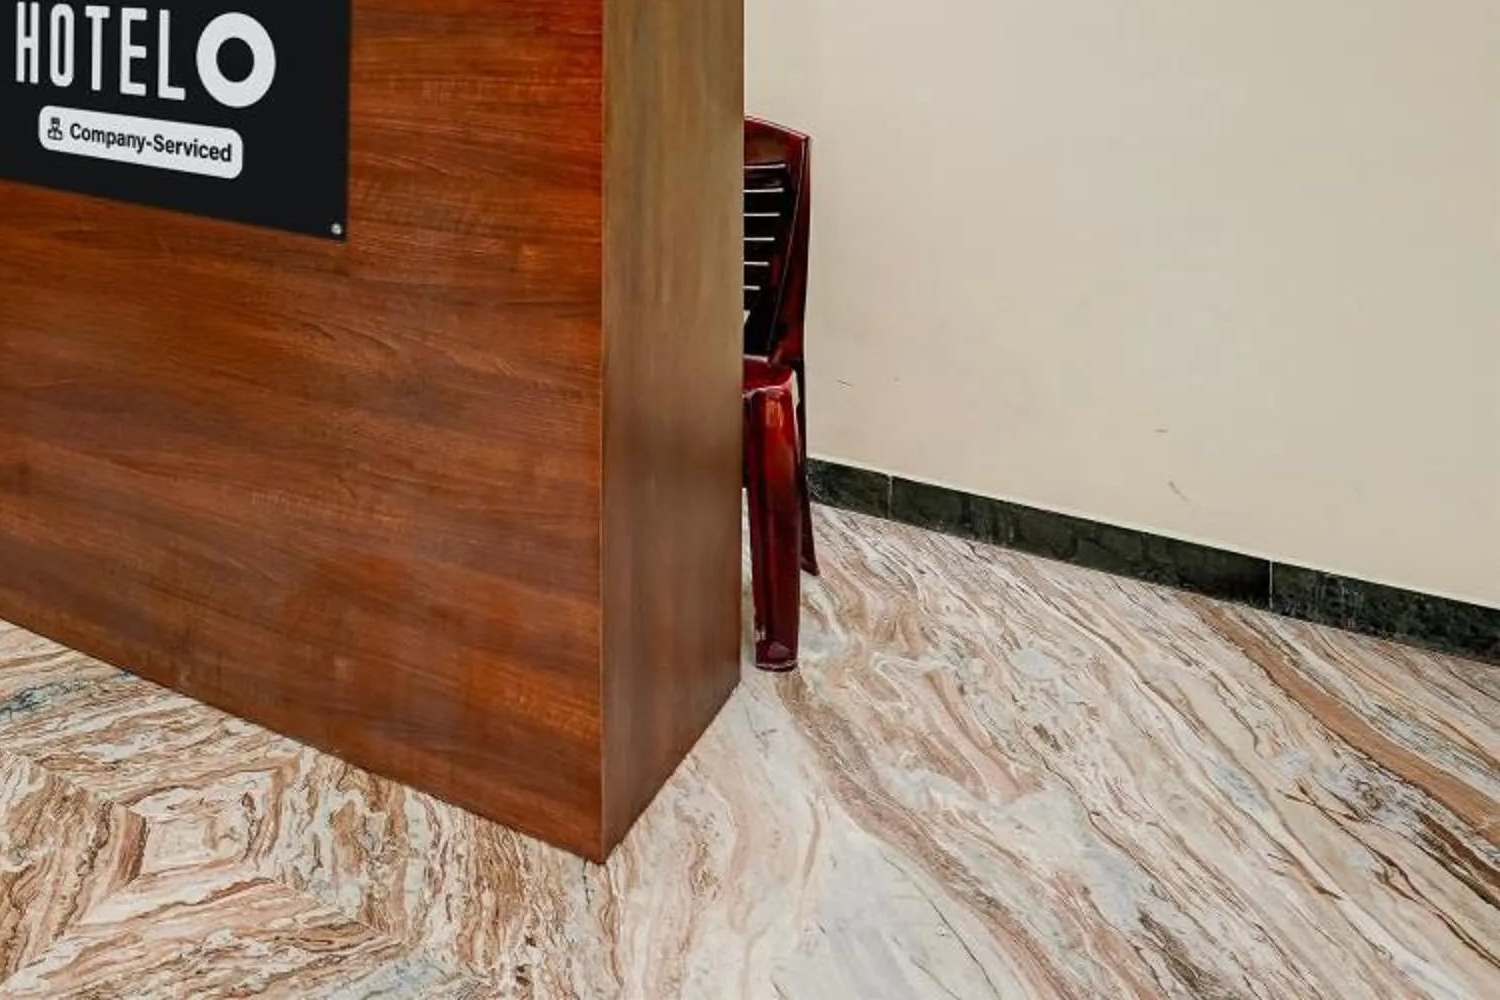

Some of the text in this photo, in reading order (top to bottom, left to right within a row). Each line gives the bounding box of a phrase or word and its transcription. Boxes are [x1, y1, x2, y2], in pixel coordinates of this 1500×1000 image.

[16, 1, 277, 108] HOTEL O
[69, 122, 233, 163] Company-Serviced
